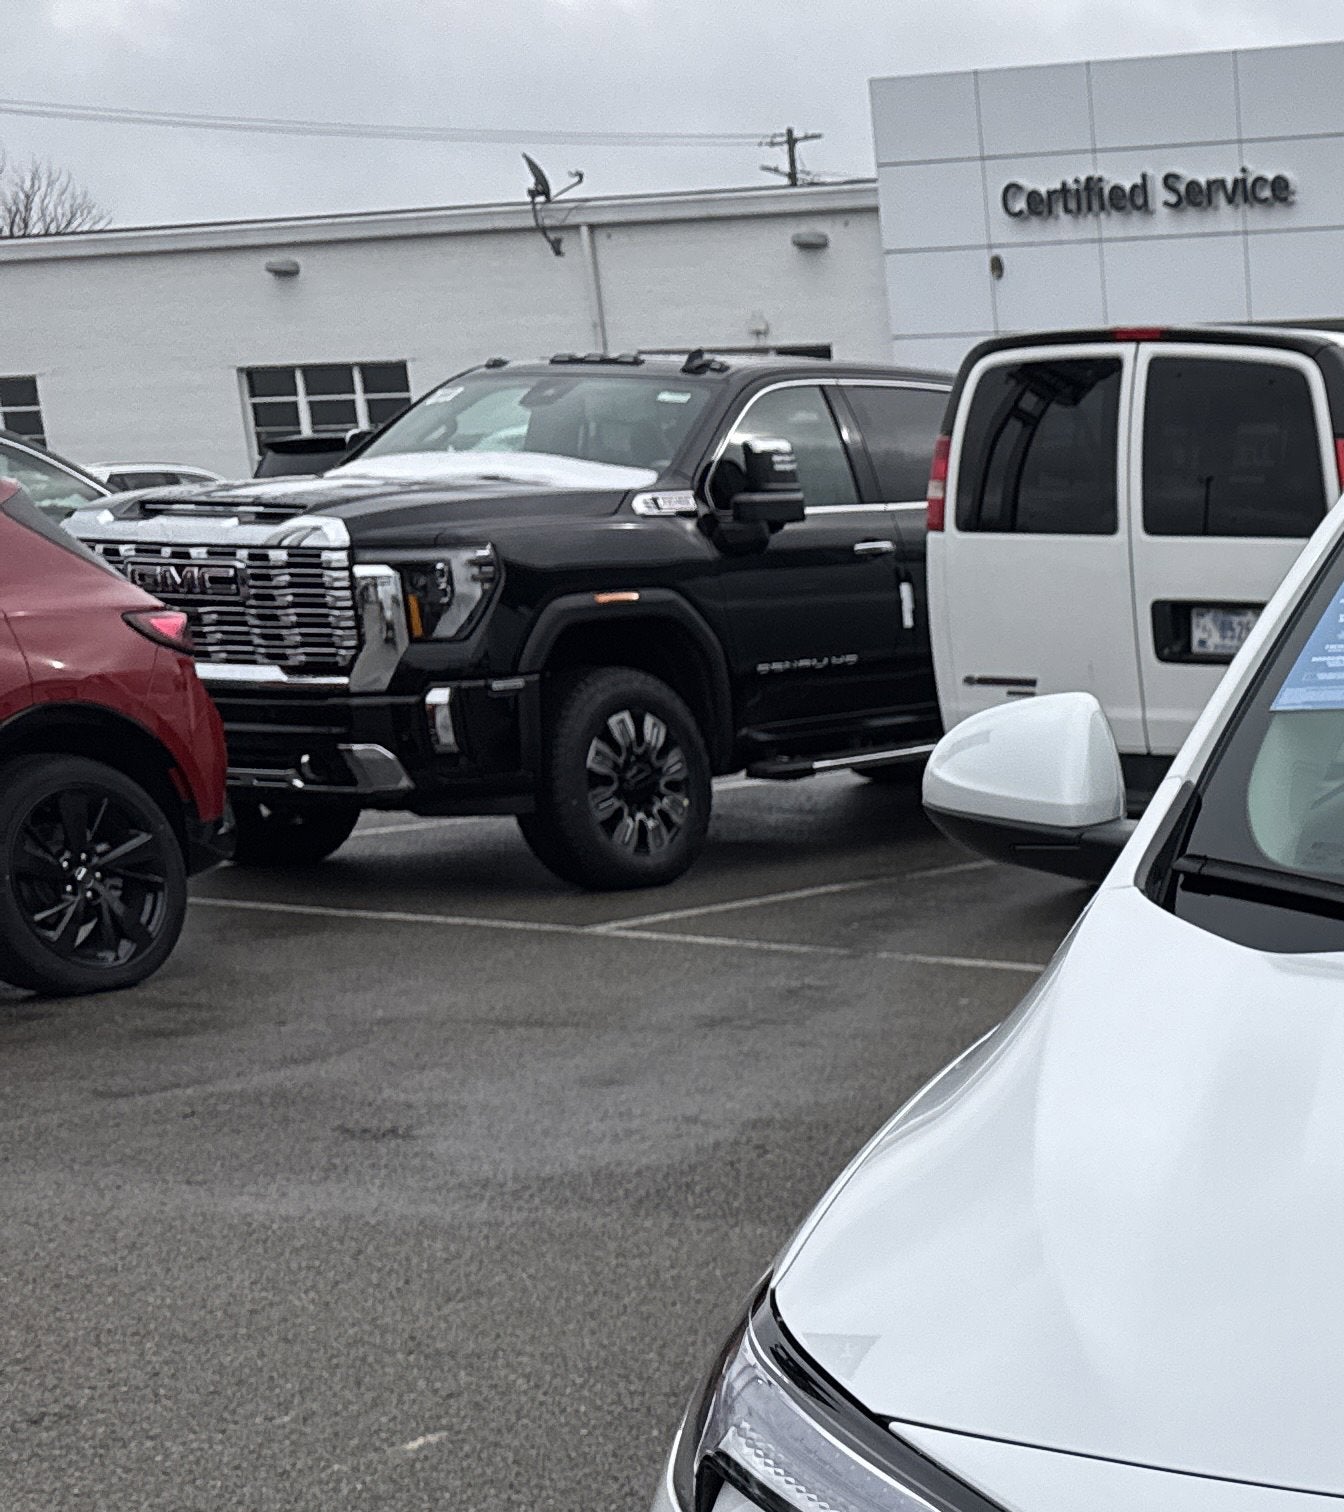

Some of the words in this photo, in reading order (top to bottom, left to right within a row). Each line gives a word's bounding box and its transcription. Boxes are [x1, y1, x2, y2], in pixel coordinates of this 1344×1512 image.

[1002, 172, 1150, 217] Certified
[1162, 167, 1291, 208] Service
[130, 564, 236, 595] GMC
